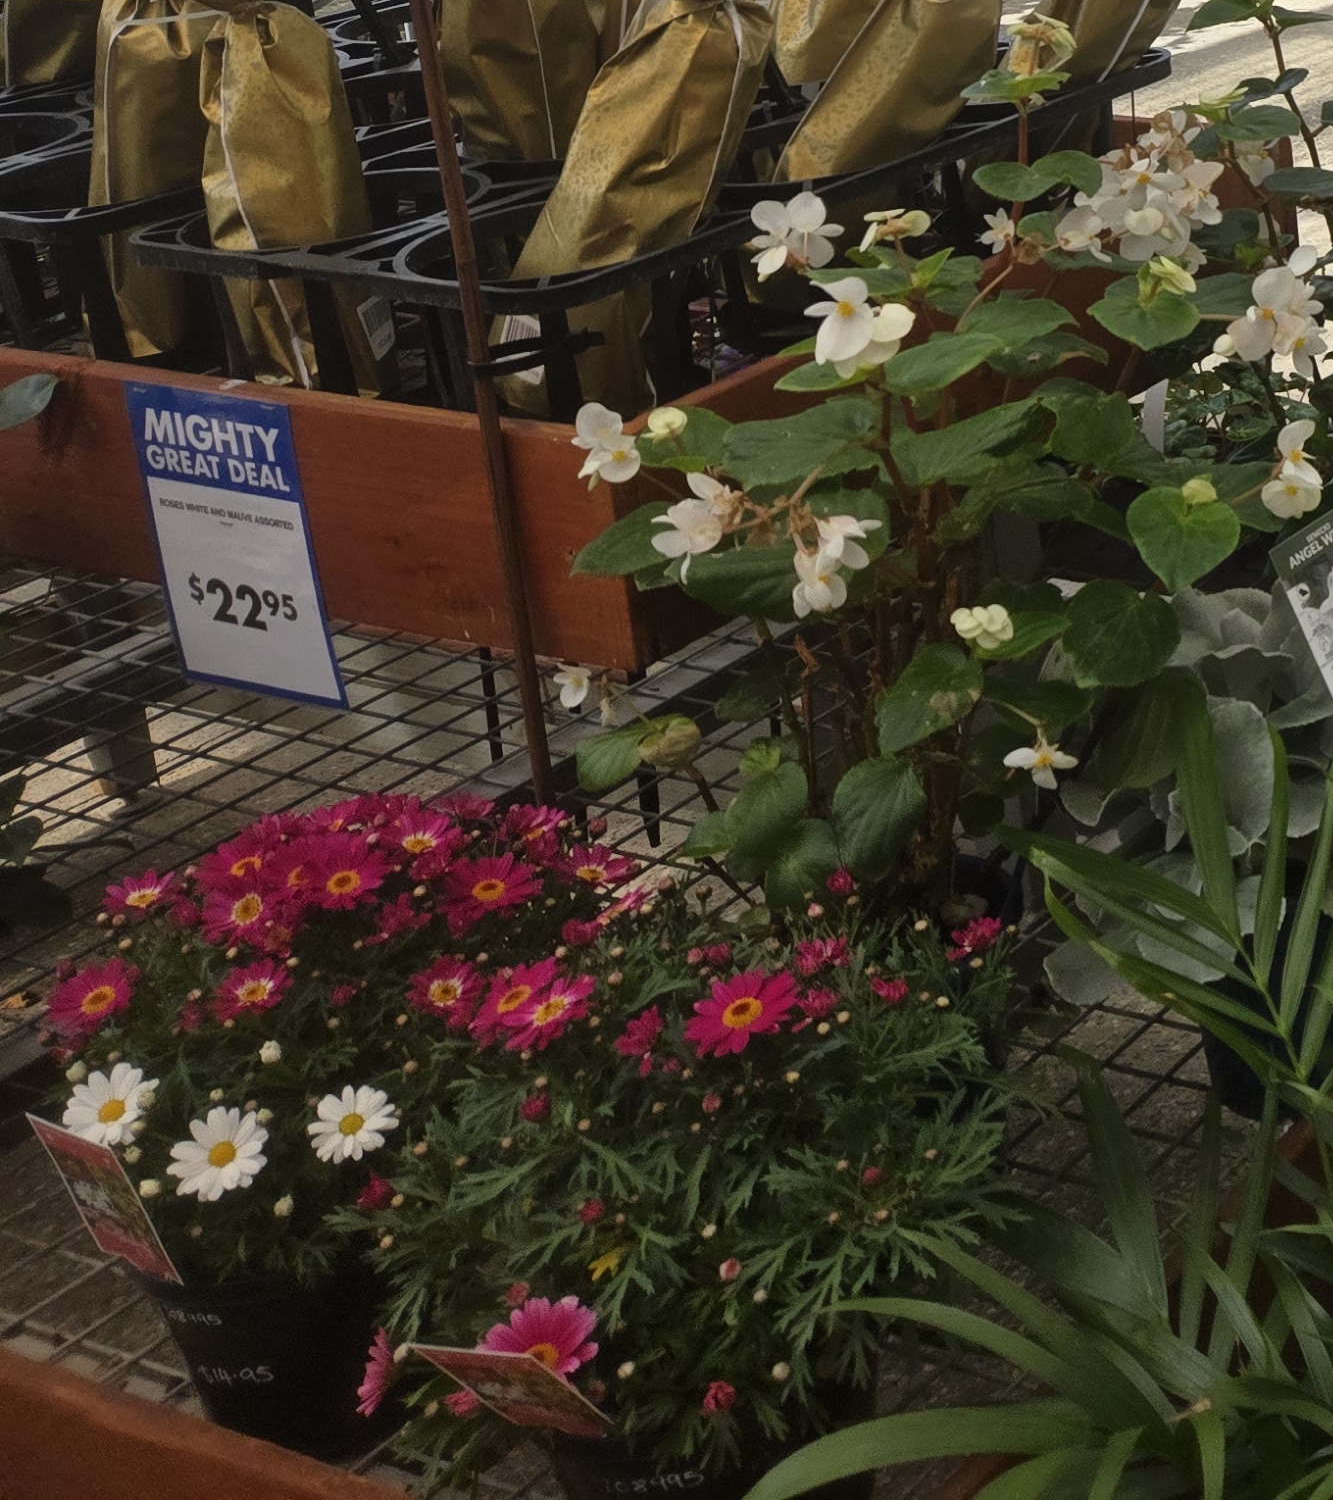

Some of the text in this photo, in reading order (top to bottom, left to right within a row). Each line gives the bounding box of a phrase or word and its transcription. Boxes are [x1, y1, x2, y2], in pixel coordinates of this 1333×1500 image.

[145, 407, 279, 462] MIGHTY
[146, 445, 290, 492] GREAT DEAL
[159, 498, 184, 510] ROSES
[186, 502, 209, 515] WHITE
[210, 507, 226, 519] AND
[227, 510, 253, 524] MAUVE
[254, 515, 294, 531] ASSORTED
[1288, 540, 1324, 570] ANGEL
